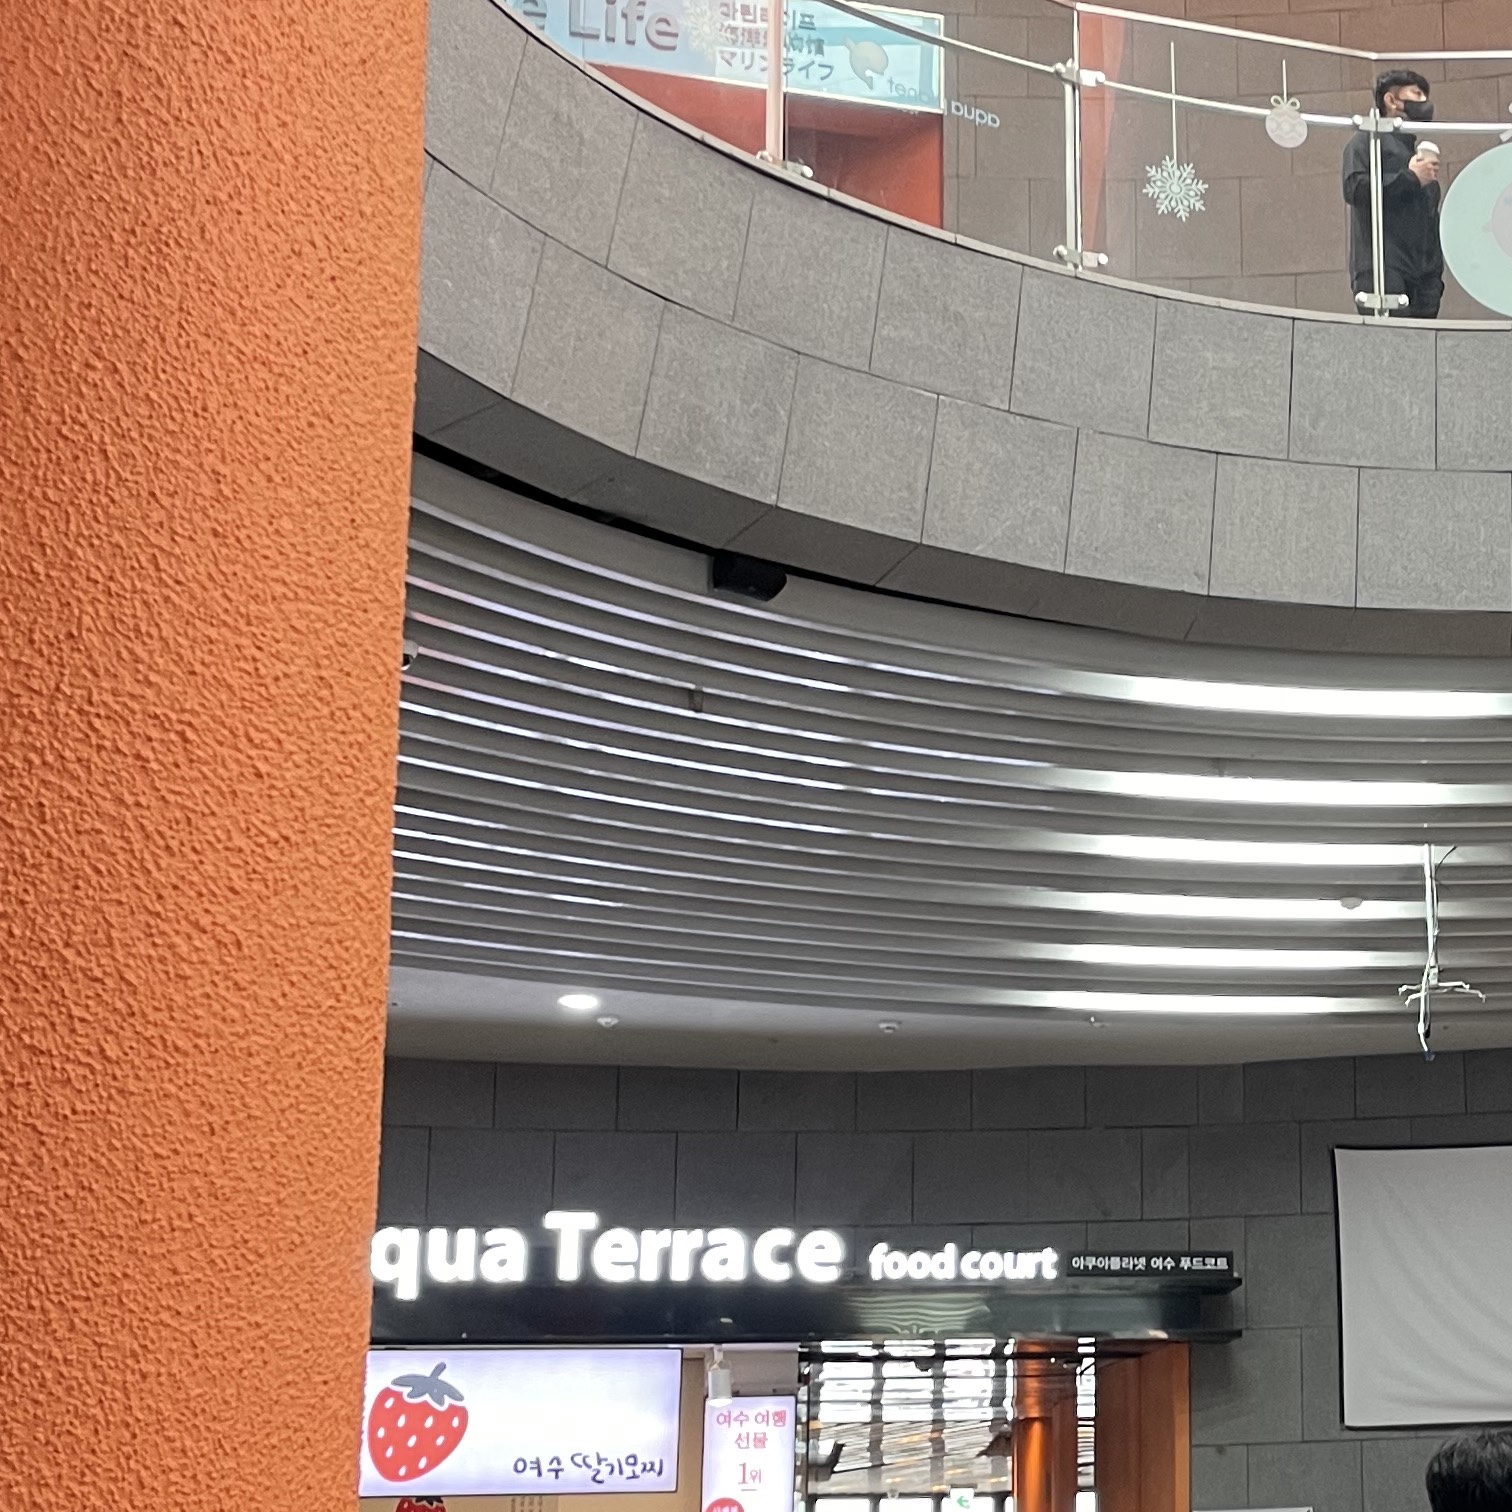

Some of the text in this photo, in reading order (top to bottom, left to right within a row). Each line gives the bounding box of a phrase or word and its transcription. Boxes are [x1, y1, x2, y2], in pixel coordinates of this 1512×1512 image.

[568, 0, 679, 51] Life
[543, 1209, 843, 1284] Terrace
[869, 1242, 957, 1281] food
[960, 1247, 1058, 1280] court
[1071, 1256, 1229, 1271] 아쿠아플라넷 여수 푸드코트
[716, 1409, 787, 1428] 여수 여행
[734, 1431, 769, 1450] 선물
[513, 1457, 565, 1480] 여수
